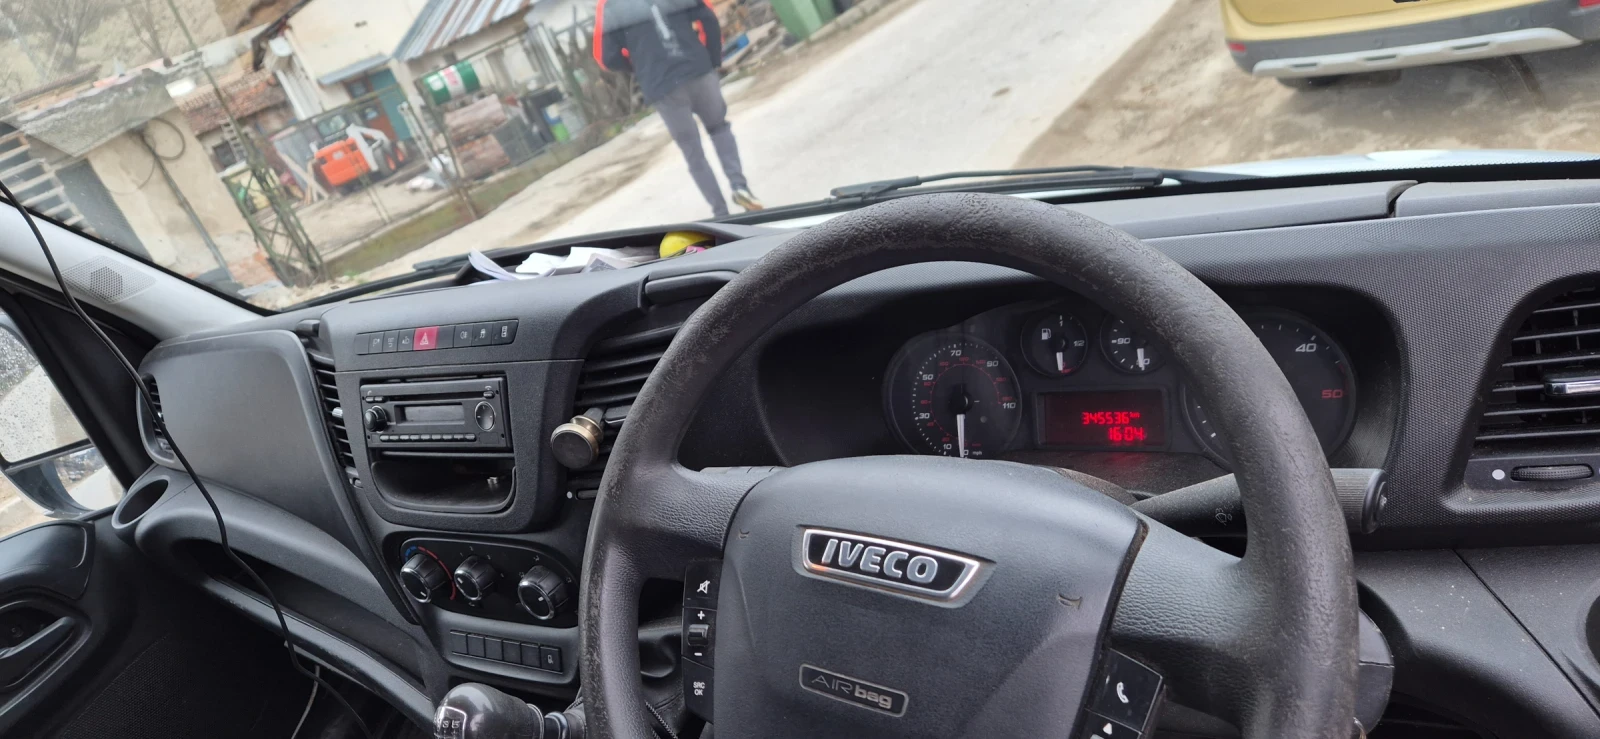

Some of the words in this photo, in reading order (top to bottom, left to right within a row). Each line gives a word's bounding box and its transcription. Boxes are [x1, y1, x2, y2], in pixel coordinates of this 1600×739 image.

[1117, 337, 1131, 345] 90
[1295, 343, 1317, 353] 40
[950, 349, 962, 357] 70
[1321, 389, 1344, 399] 50
[1082, 411, 1130, 425] 345536
[821, 538, 939, 584] IVECO
[693, 681, 706, 689] SRC
[694, 688, 703, 696] OK
